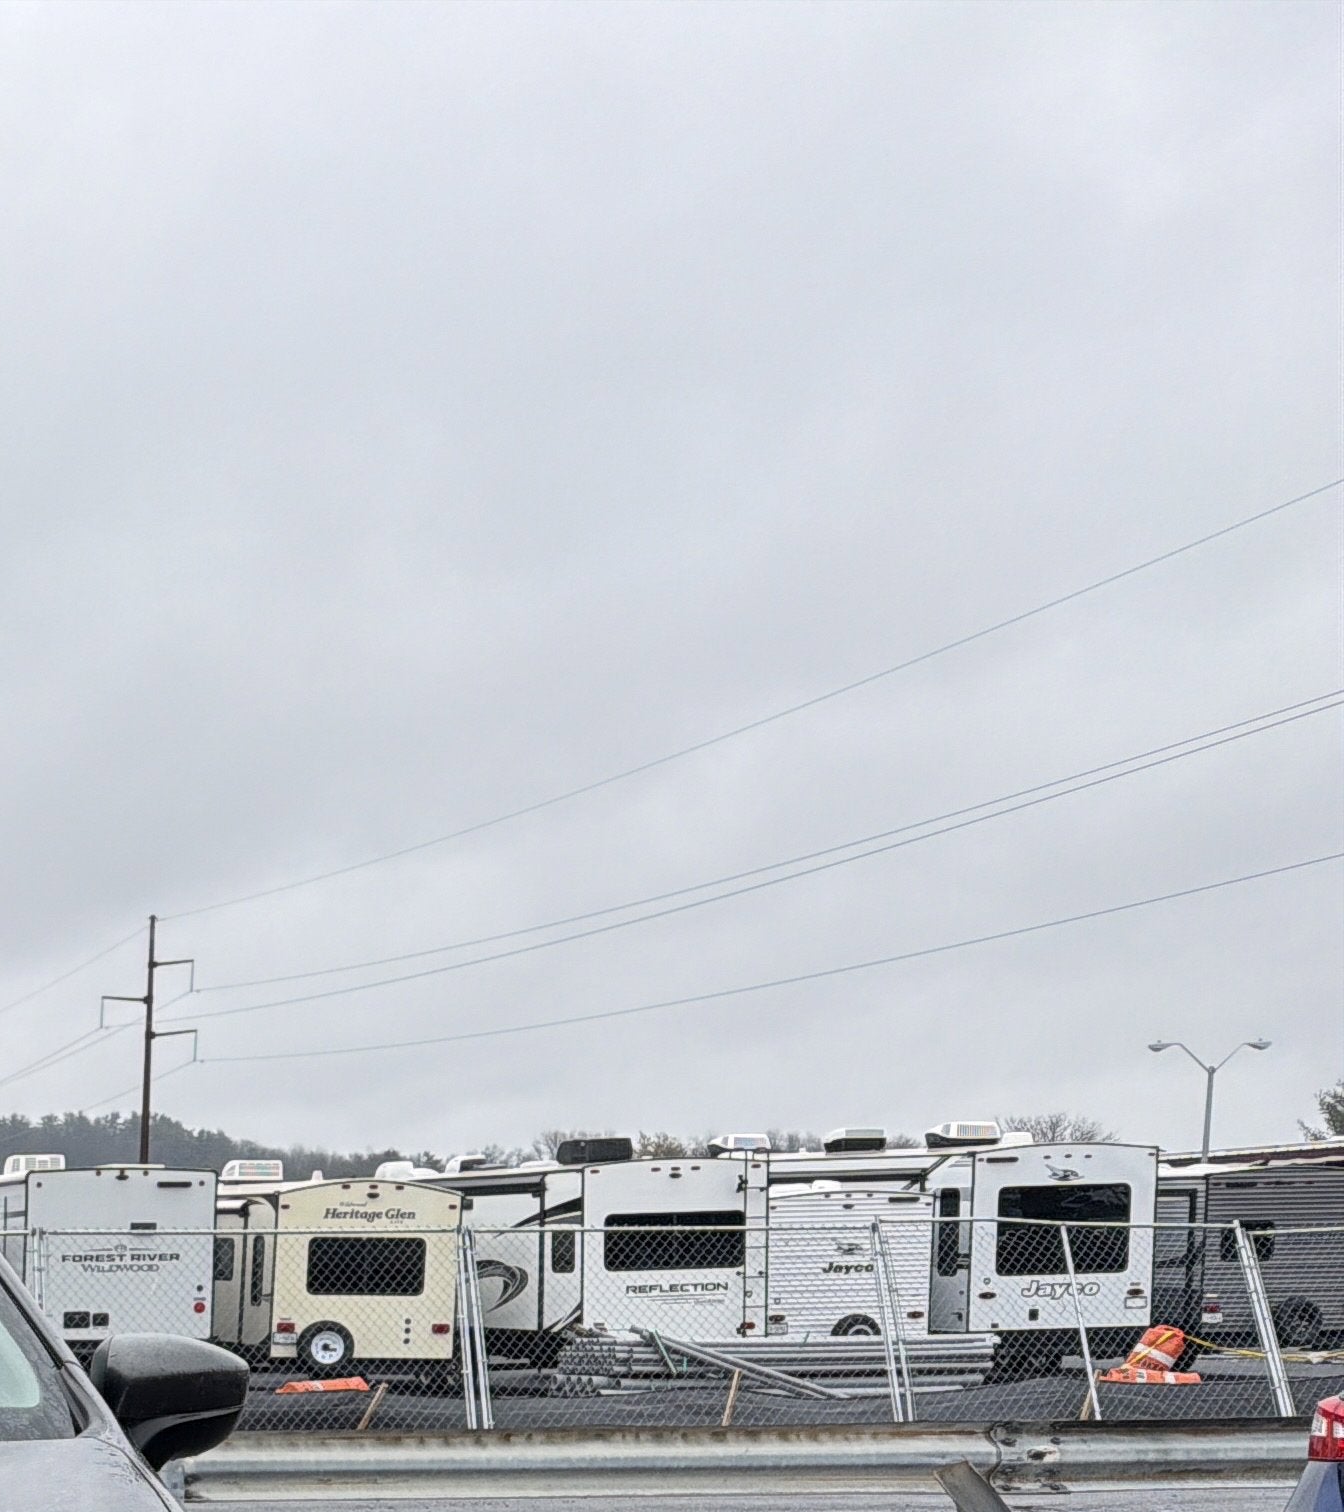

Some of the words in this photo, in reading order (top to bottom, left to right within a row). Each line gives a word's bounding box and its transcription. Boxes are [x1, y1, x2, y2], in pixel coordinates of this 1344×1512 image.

[323, 1207, 383, 1223] Heritage
[385, 1207, 416, 1219] Glen
[62, 1253, 127, 1262] FOREST
[130, 1253, 180, 1261] RIVER
[822, 1261, 874, 1275] Jayco
[626, 1282, 729, 1294] REFLECTION
